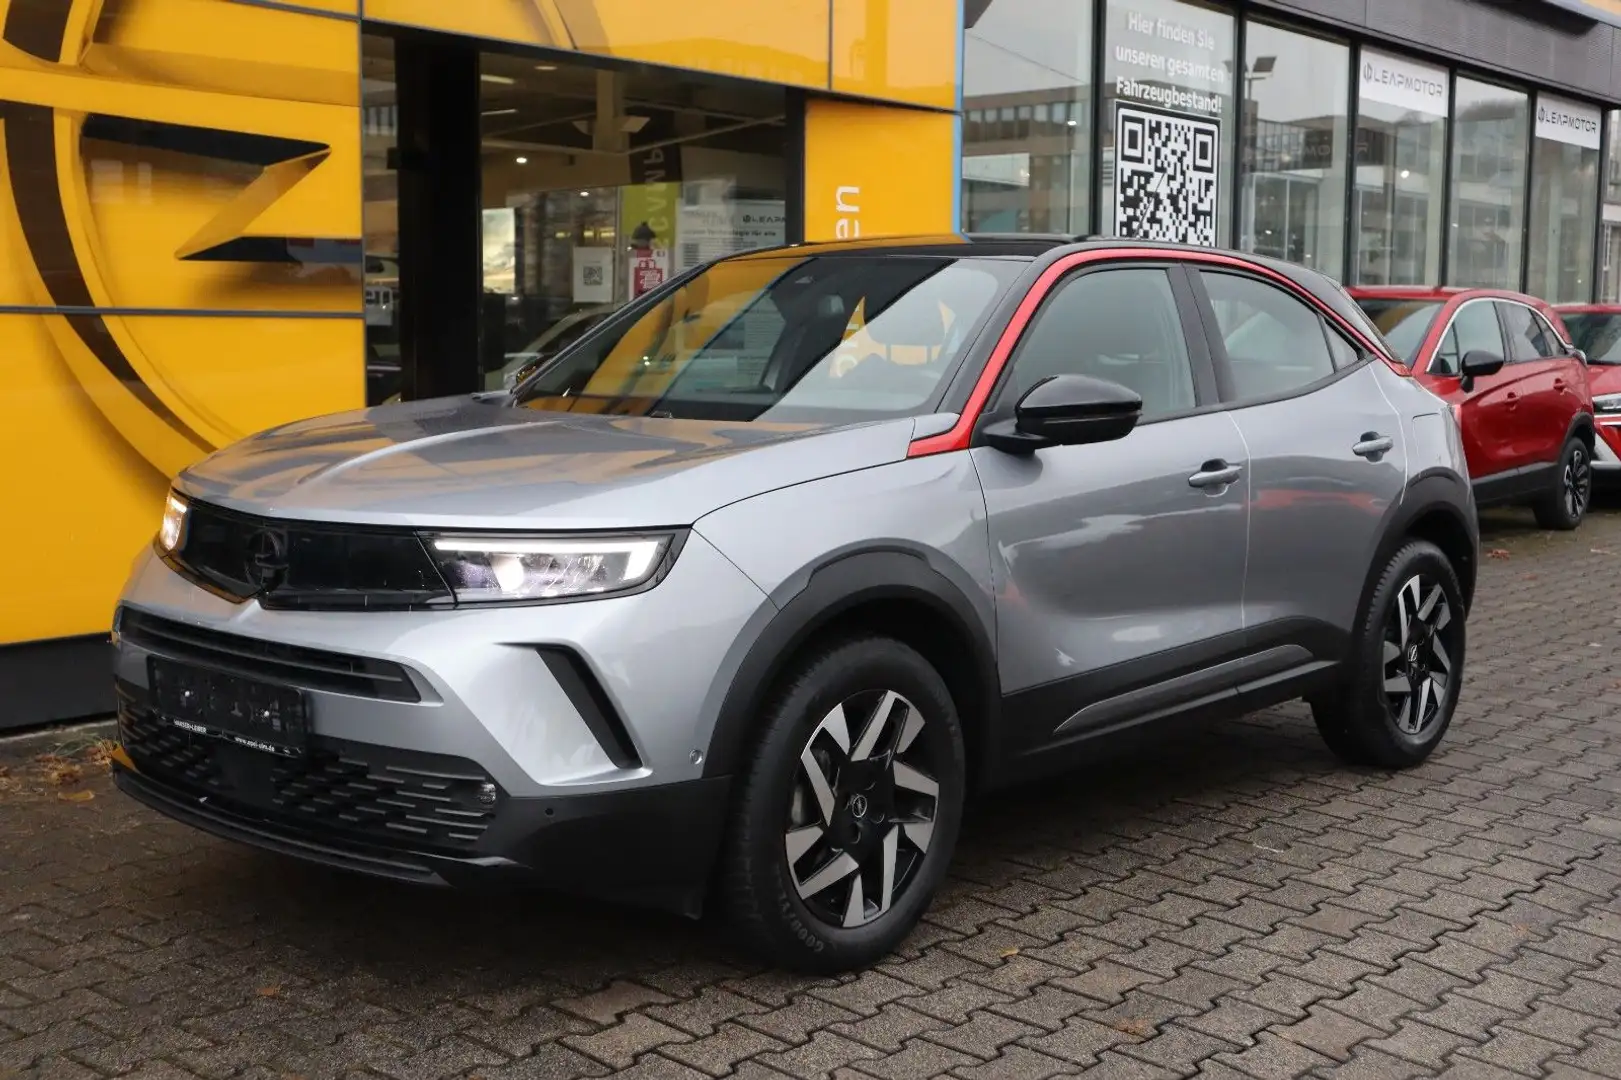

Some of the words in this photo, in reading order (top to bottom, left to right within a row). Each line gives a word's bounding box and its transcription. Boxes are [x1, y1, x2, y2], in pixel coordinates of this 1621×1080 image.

[1128, 11, 1154, 36] Hier
[1156, 18, 1195, 46] finden
[1197, 29, 1215, 50] Sie
[1115, 45, 1165, 71] unseren
[1167, 60, 1225, 83] gesamten
[1373, 68, 1443, 98] LEAPMOTOR
[1116, 75, 1222, 113] Fahrzeugbestand!
[1545, 108, 1597, 134] LEAPMOTOR
